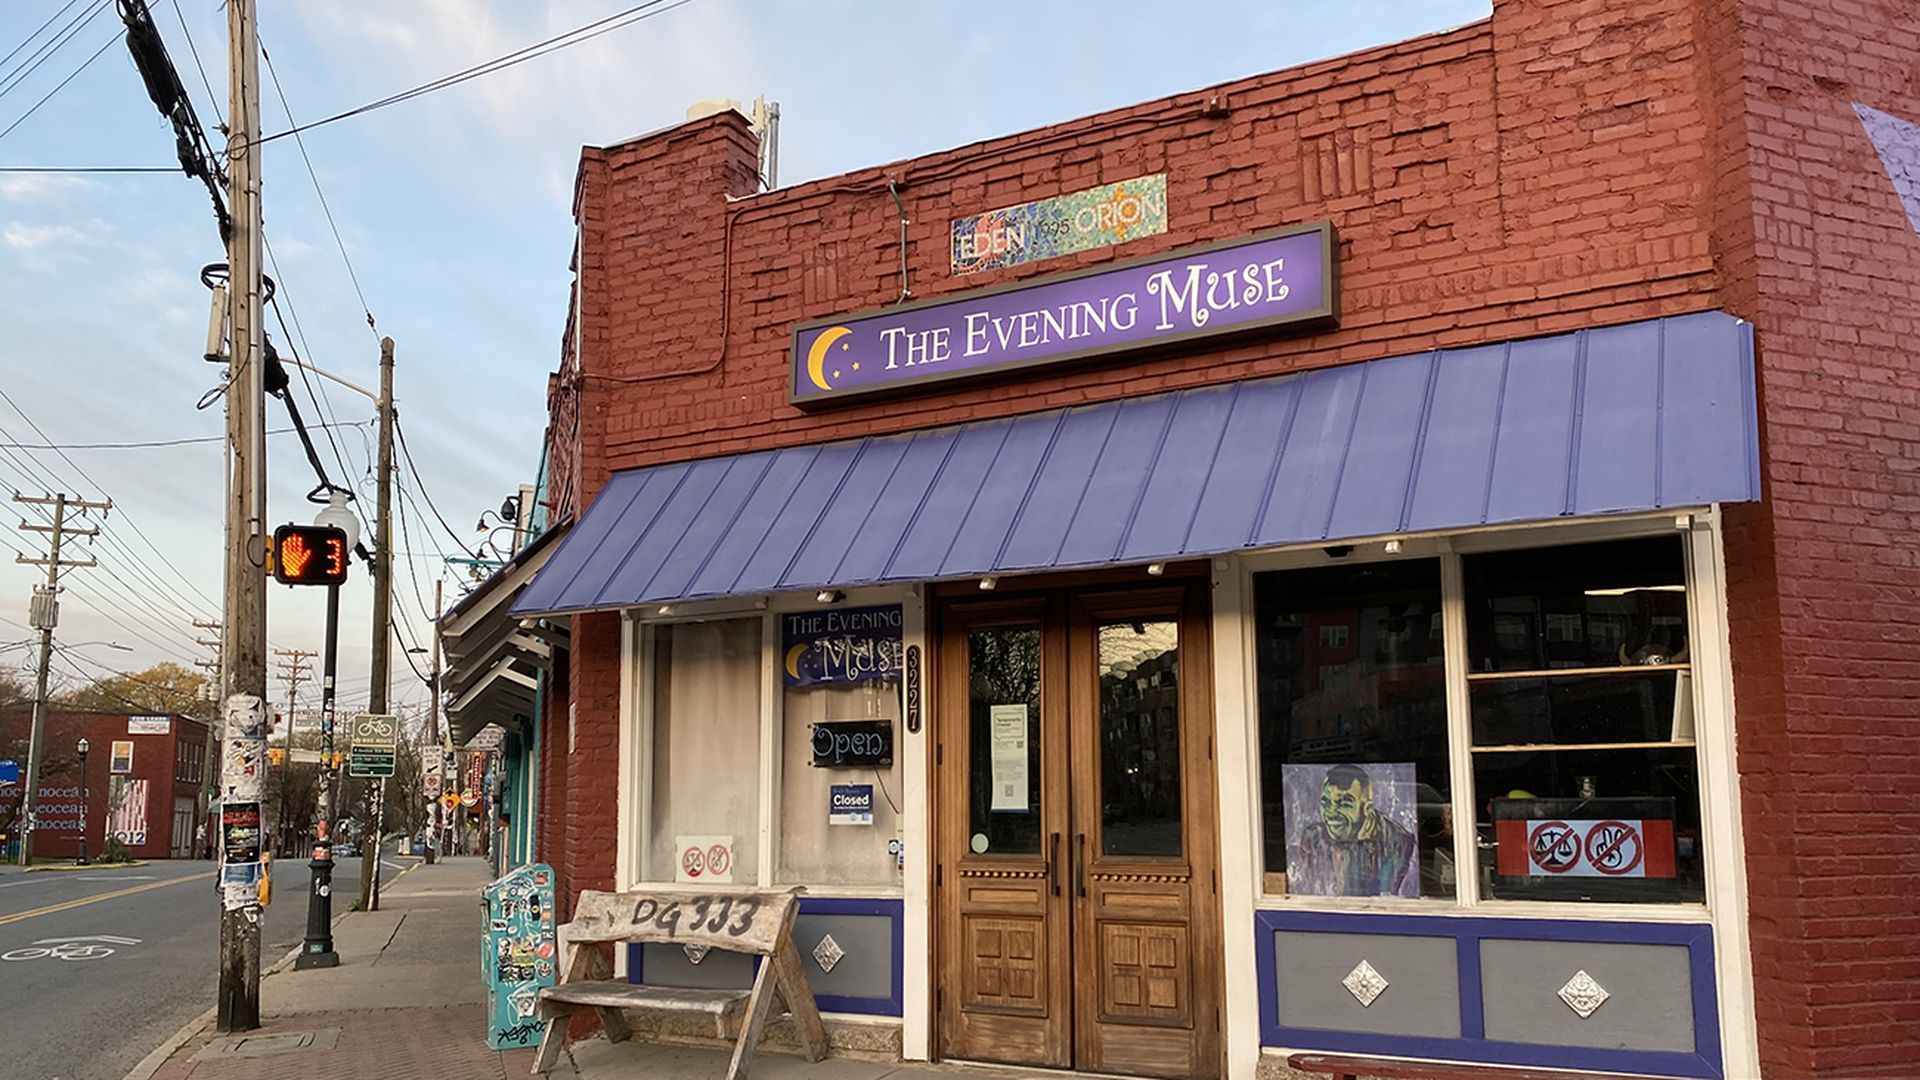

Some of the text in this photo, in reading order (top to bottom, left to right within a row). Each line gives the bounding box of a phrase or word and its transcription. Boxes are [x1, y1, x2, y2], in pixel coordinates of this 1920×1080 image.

[960, 226, 1025, 259] EDEN
[1074, 191, 1162, 233] ORION
[326, 539, 340, 574] 3
[909, 648, 918, 729] 3227
[813, 727, 883, 764] Open
[833, 794, 870, 806] Closed
